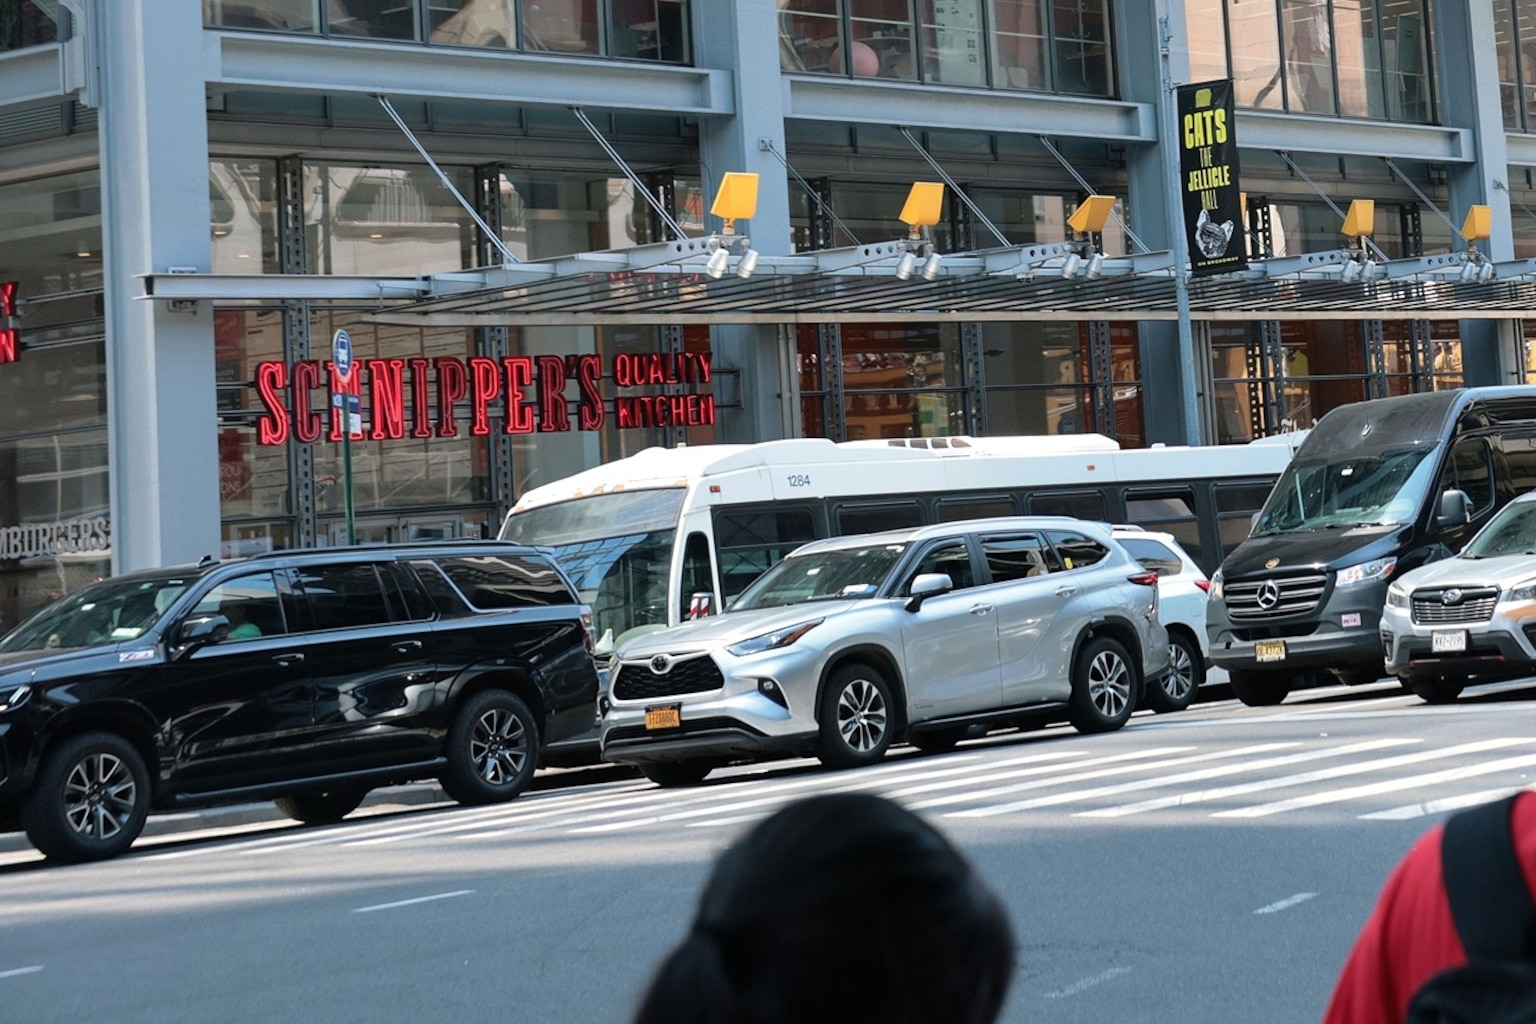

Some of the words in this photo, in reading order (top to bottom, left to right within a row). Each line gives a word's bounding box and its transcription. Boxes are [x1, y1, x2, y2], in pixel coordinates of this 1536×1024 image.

[1183, 107, 1228, 150] CATS
[1199, 147, 1213, 168] THE
[1188, 165, 1231, 193] JELLICLE
[1207, 255, 1240, 266] BROADWAY
[612, 351, 714, 387] QUALITY
[255, 353, 606, 446] SCHNIPPER'S
[614, 394, 716, 429] KITCHEN
[787, 474, 811, 487] 1284
